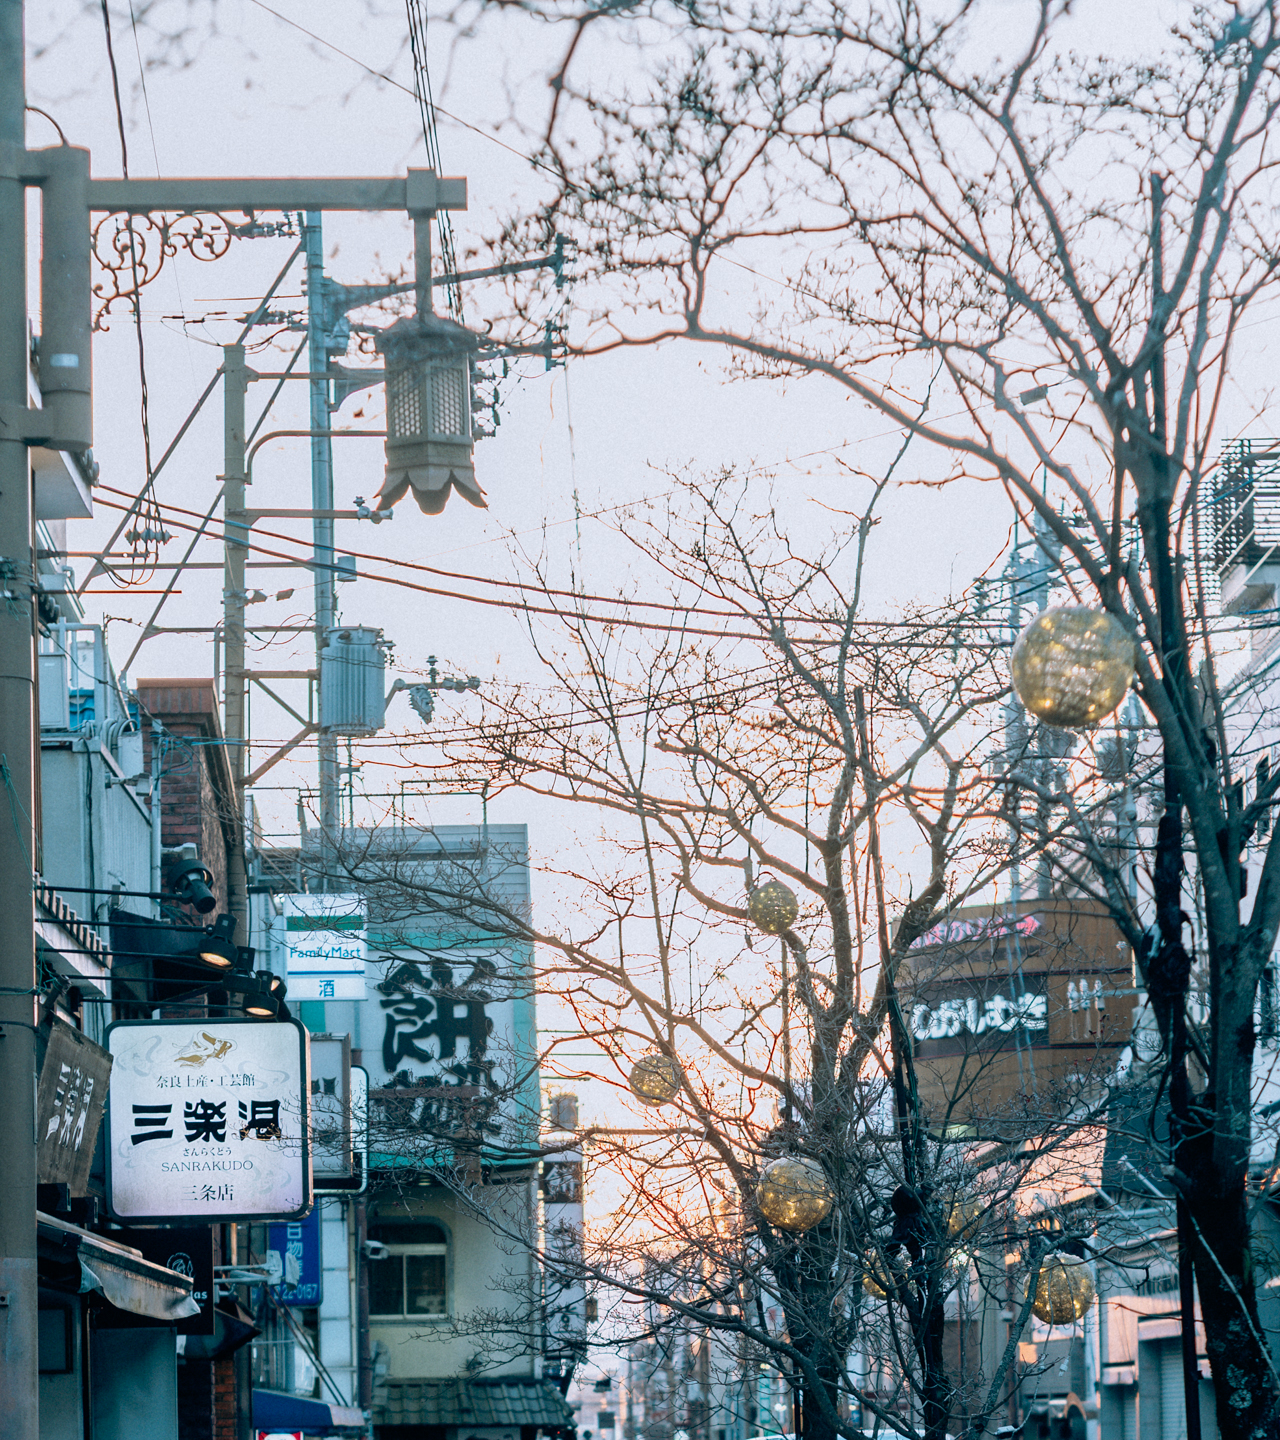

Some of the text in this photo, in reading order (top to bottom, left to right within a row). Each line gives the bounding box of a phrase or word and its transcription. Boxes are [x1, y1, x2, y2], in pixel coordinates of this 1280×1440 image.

[289, 945, 361, 960] FamilyMart
[319, 979, 335, 997] 酒
[156, 1073, 256, 1089] 奈良土産・工芸館
[131, 1098, 282, 1146] 三楽洞
[182, 1147, 232, 1157] さんらくどう
[161, 1160, 254, 1172] SANRAKUDO
[182, 1184, 234, 1202] 三条店
